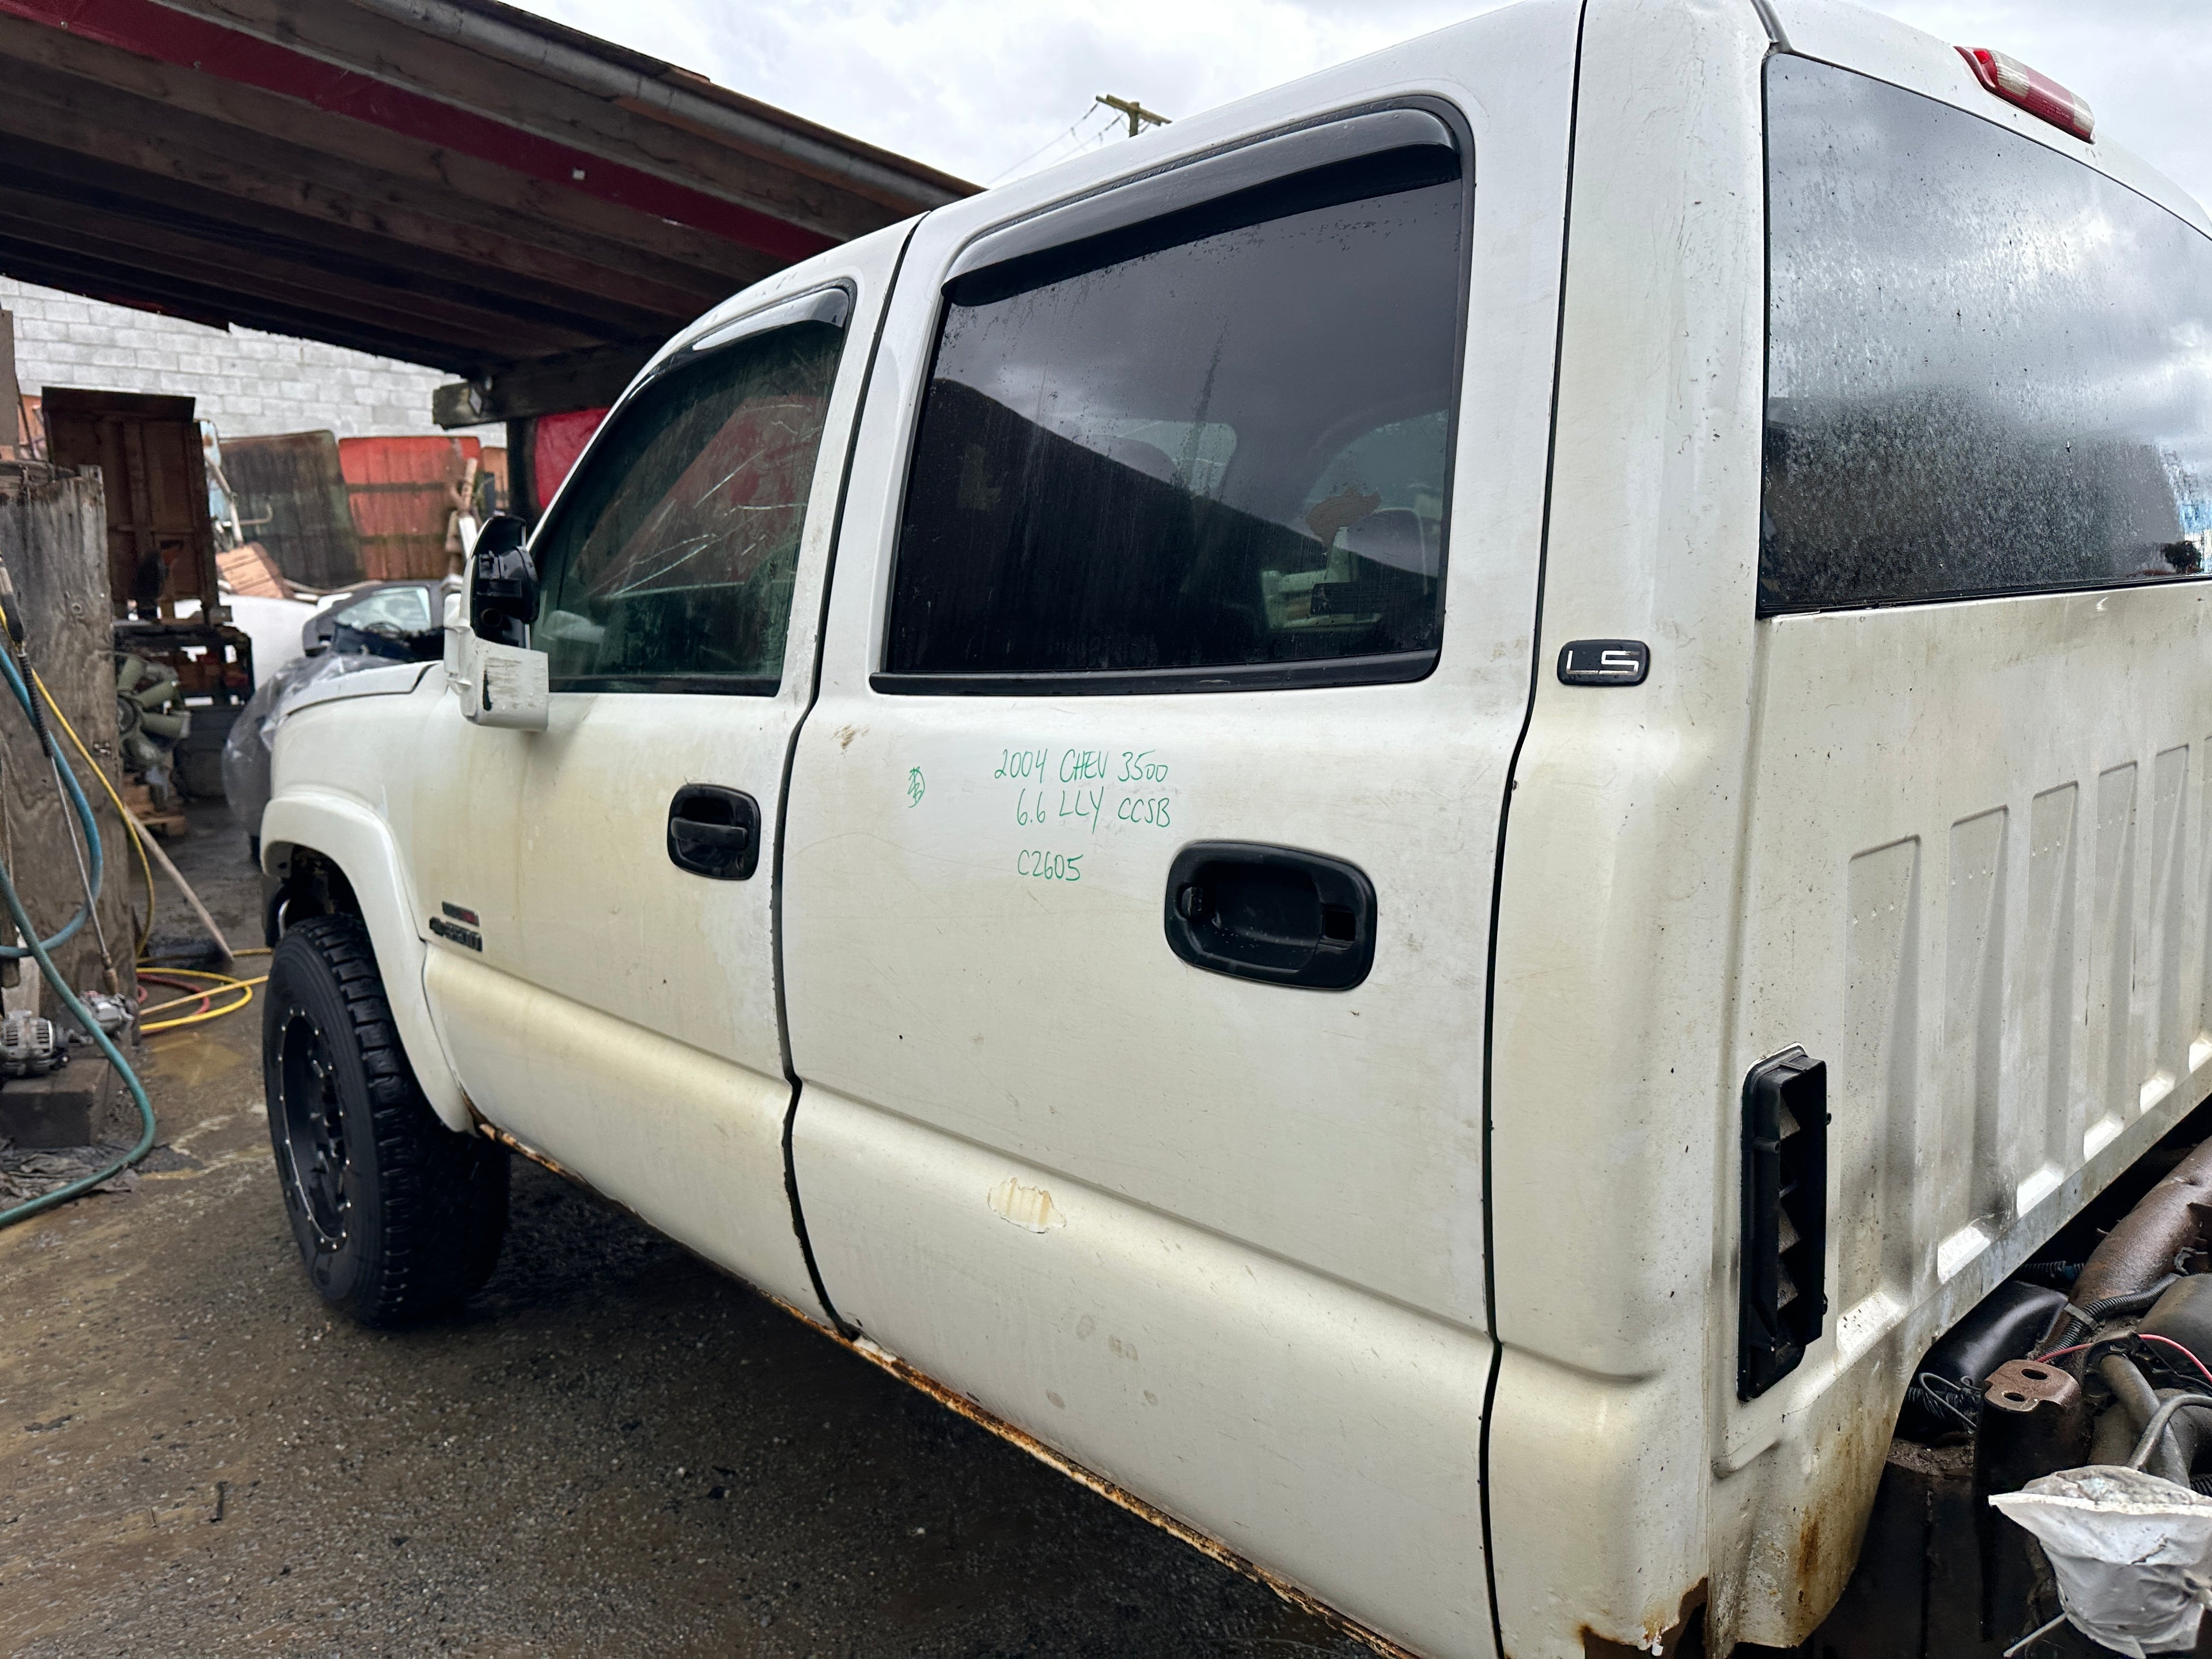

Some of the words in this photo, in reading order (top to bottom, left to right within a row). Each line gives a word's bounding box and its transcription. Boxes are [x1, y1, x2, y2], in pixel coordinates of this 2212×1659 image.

[1566, 650, 1640, 676] LS
[994, 749, 1047, 783] 2004
[1059, 749, 1109, 783] CHEV
[1117, 749, 1168, 783] 3500
[1017, 788, 1046, 826] 6.6
[1059, 786, 1104, 835] LLY
[1118, 797, 1171, 828] CCSB
[1017, 850, 1084, 881] C2605
